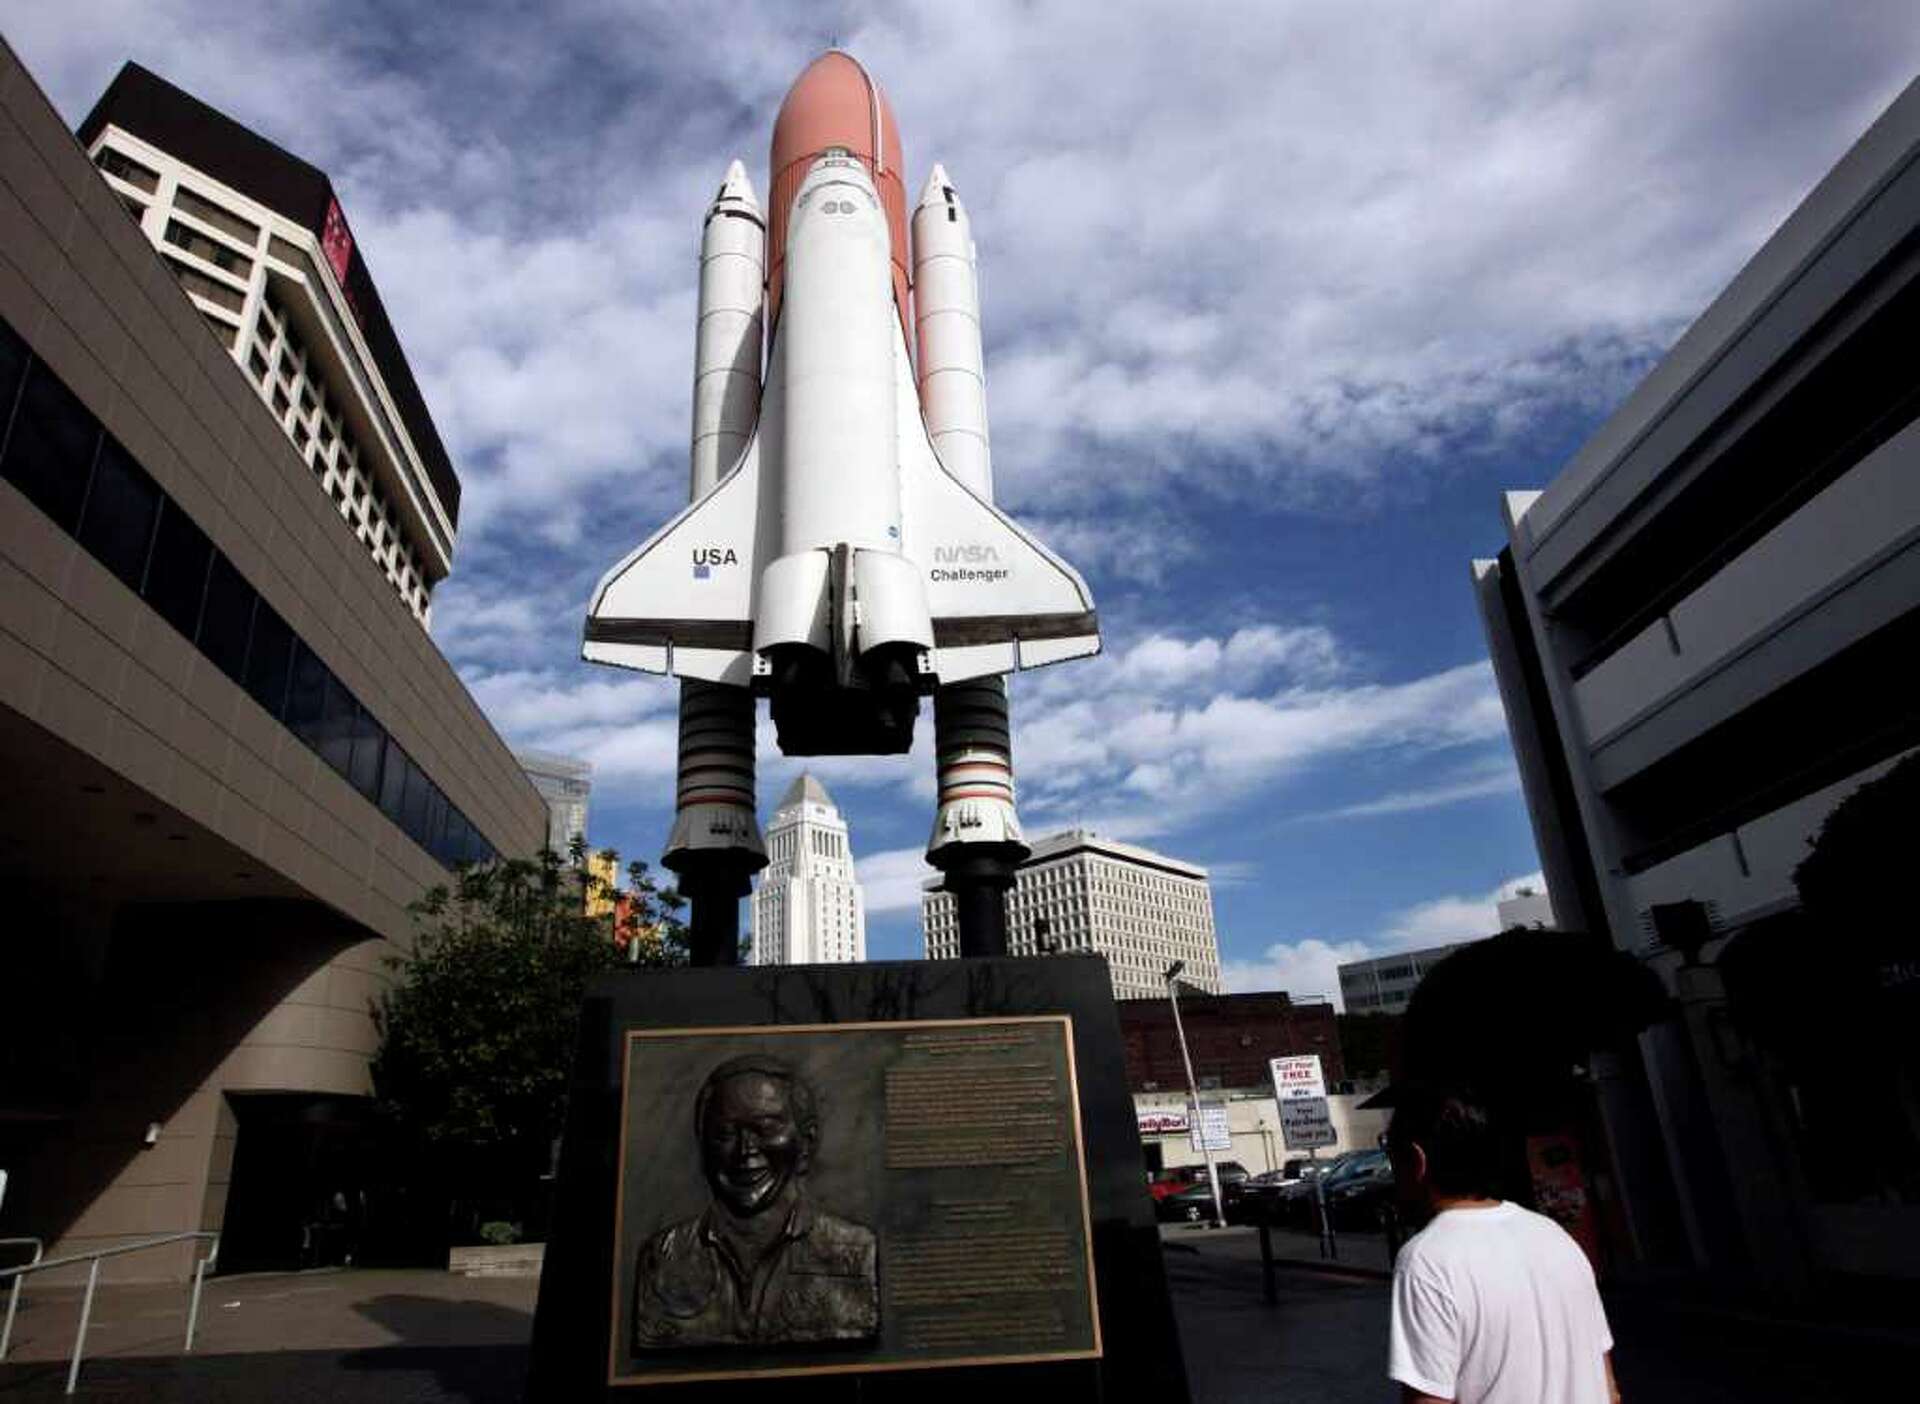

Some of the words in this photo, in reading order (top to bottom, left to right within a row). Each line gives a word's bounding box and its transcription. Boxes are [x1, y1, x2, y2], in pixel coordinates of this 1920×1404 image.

[693, 549, 738, 565] USA
[934, 546, 999, 562] NASA
[931, 569, 1007, 583] Challenger
